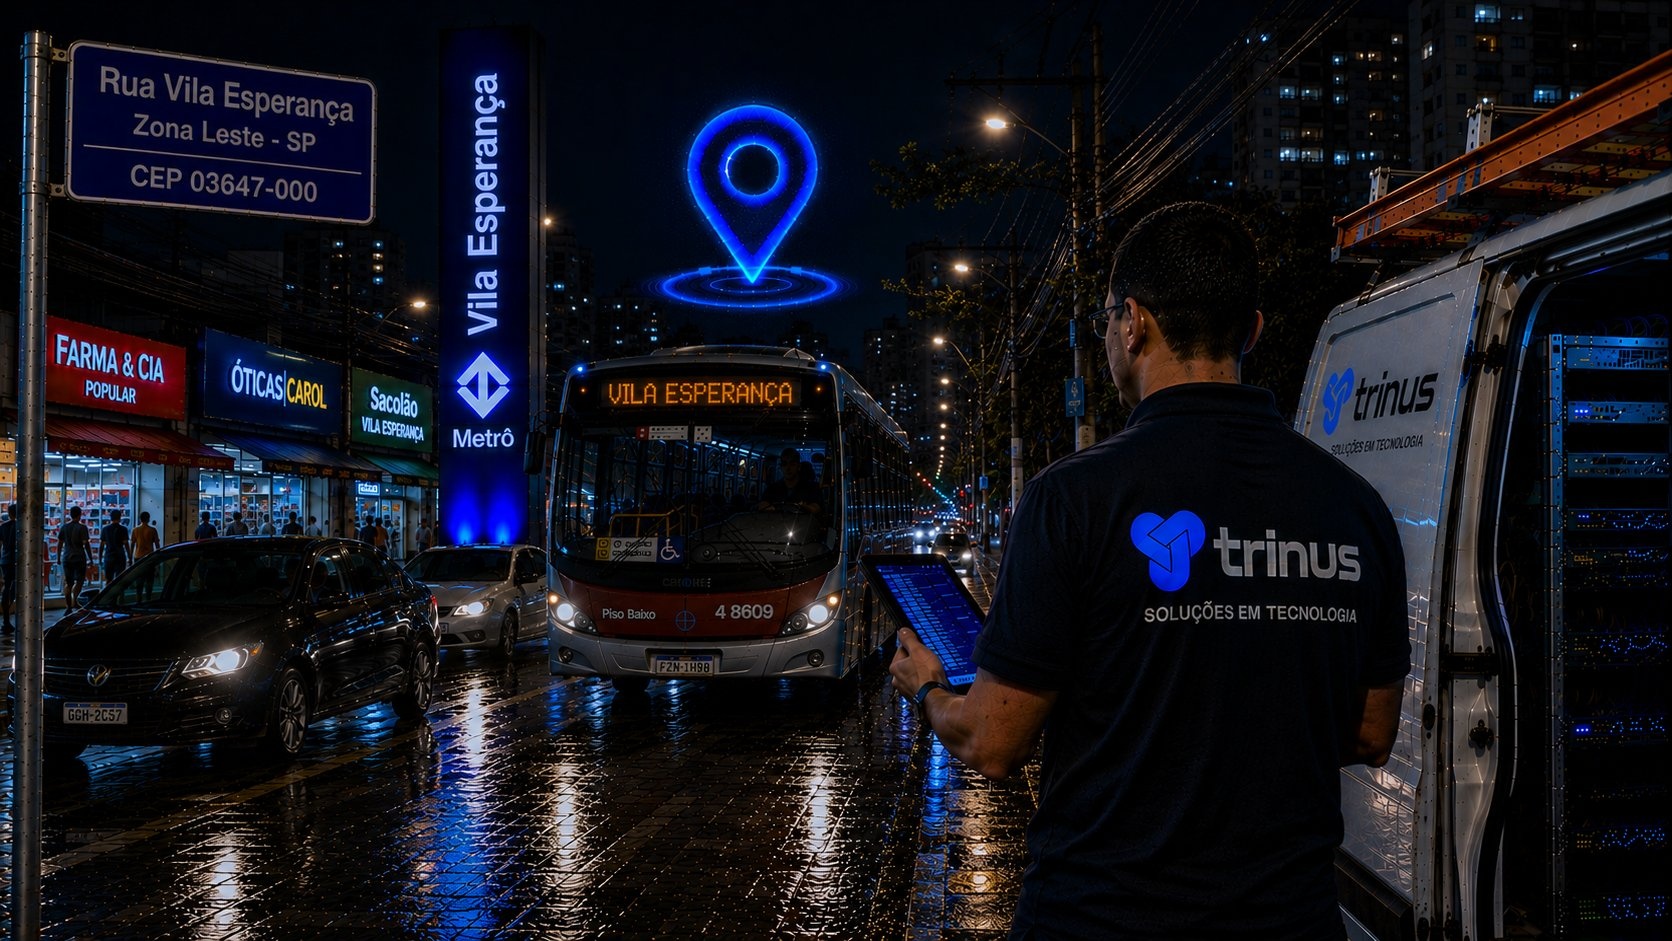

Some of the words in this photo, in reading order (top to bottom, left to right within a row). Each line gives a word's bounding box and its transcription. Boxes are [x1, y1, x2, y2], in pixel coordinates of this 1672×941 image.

[100, 65, 155, 99] Rua
[164, 73, 214, 106] Vila
[224, 81, 354, 126] Esperança
[133, 113, 193, 141] Zona
[202, 120, 264, 148] Leste
[287, 132, 316, 152] SP
[467, 73, 506, 256] Esperança
[130, 164, 182, 189] CEP
[190, 170, 318, 202] 03647-000
[467, 270, 498, 336] Vila
[55, 334, 118, 375] FARMA
[122, 351, 135, 378] &
[137, 353, 165, 383] CIA
[85, 379, 136, 404] POPULAR
[231, 358, 283, 401] ÓTICAS
[286, 377, 328, 410] CAROL
[608, 382, 657, 405] VILA
[665, 381, 793, 407] ESPERANÇA
[1353, 370, 1439, 422] trinus
[370, 386, 418, 418] Sacolão
[361, 416, 380, 433] VILA
[381, 420, 424, 443] ESPERANÇA
[452, 427, 515, 448] Metrô
[1376, 434, 1424, 452] TECNOLOGIA
[1213, 526, 1361, 582] trinus
[602, 608, 624, 620] Piso
[627, 609, 656, 620] Baixo
[715, 605, 727, 619] 4
[730, 604, 774, 620] 8609
[1144, 601, 1234, 624] SOLUÇÕES
[1238, 605, 1261, 620] EM
[1266, 605, 1357, 623] TECNOLOGIA
